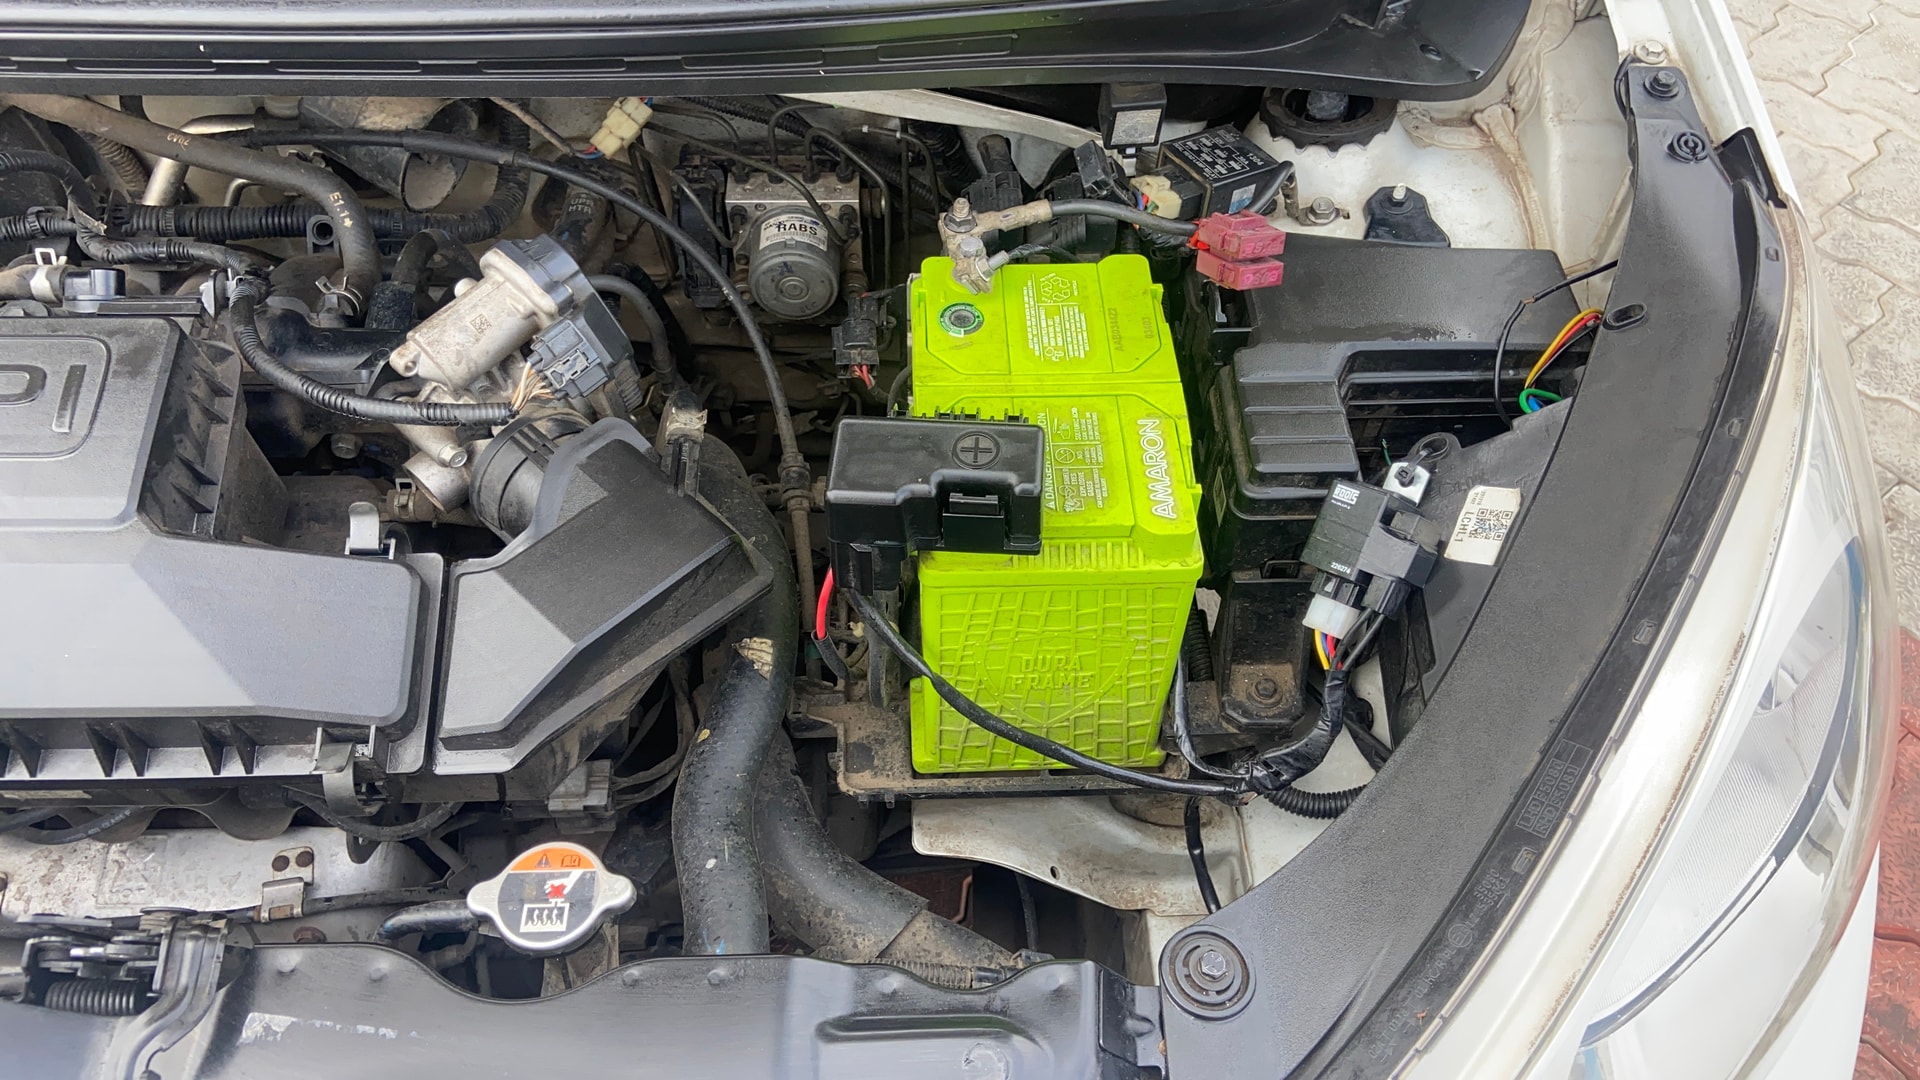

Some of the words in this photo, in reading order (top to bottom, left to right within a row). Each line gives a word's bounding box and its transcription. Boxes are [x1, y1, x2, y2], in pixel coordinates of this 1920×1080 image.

[1137, 419, 1177, 519] AMARON
[1454, 511, 1475, 542] LCHL1
[1021, 655, 1082, 672] DURA
[1009, 672, 1091, 690] FRAME
